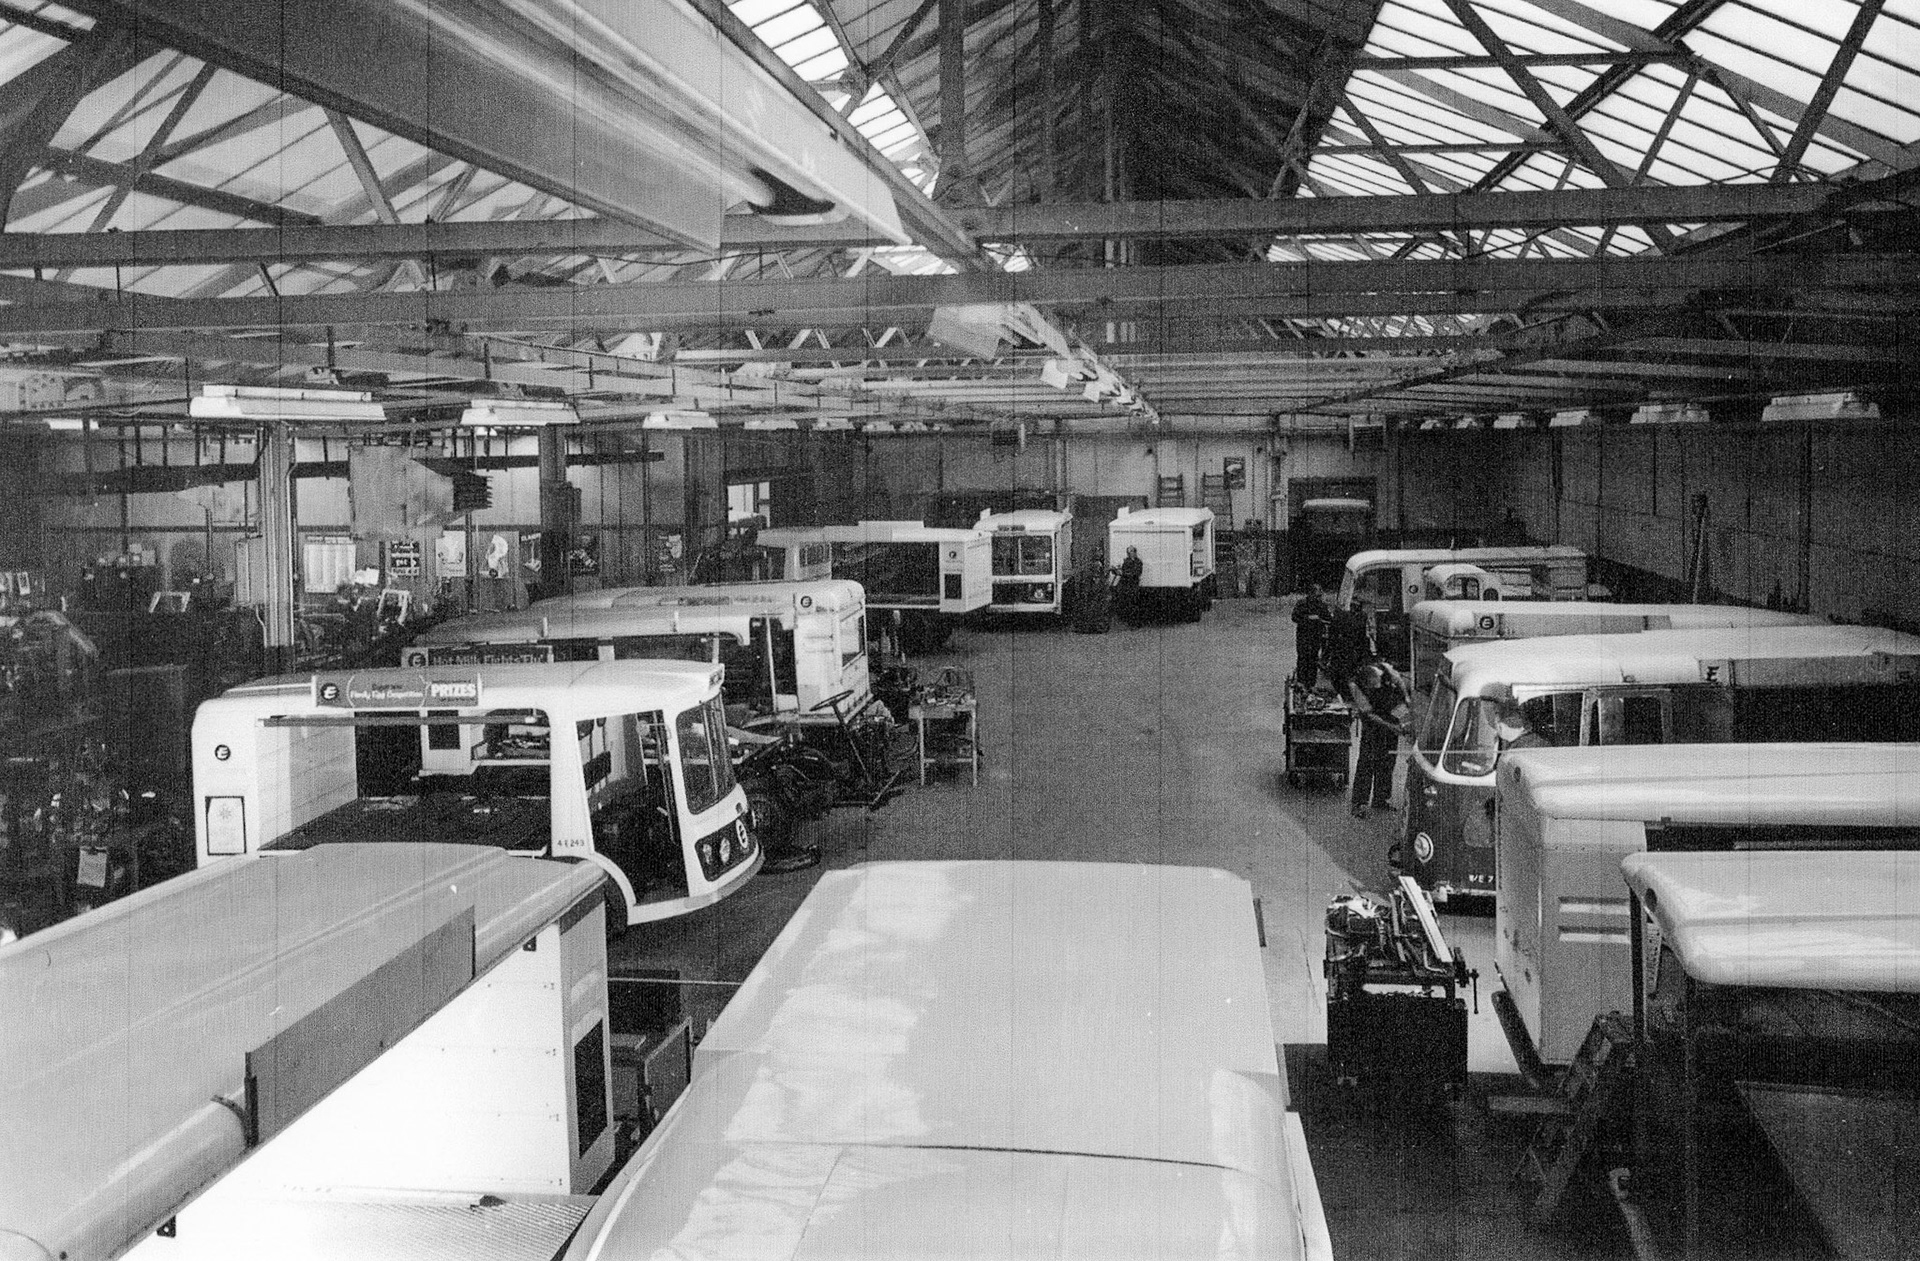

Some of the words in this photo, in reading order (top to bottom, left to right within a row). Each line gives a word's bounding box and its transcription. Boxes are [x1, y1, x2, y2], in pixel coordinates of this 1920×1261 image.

[1481, 617, 1493, 629] E
[1706, 665, 1720, 682] E
[323, 685, 338, 700] E
[431, 683, 476, 697] PRIZES
[216, 745, 230, 759] E
